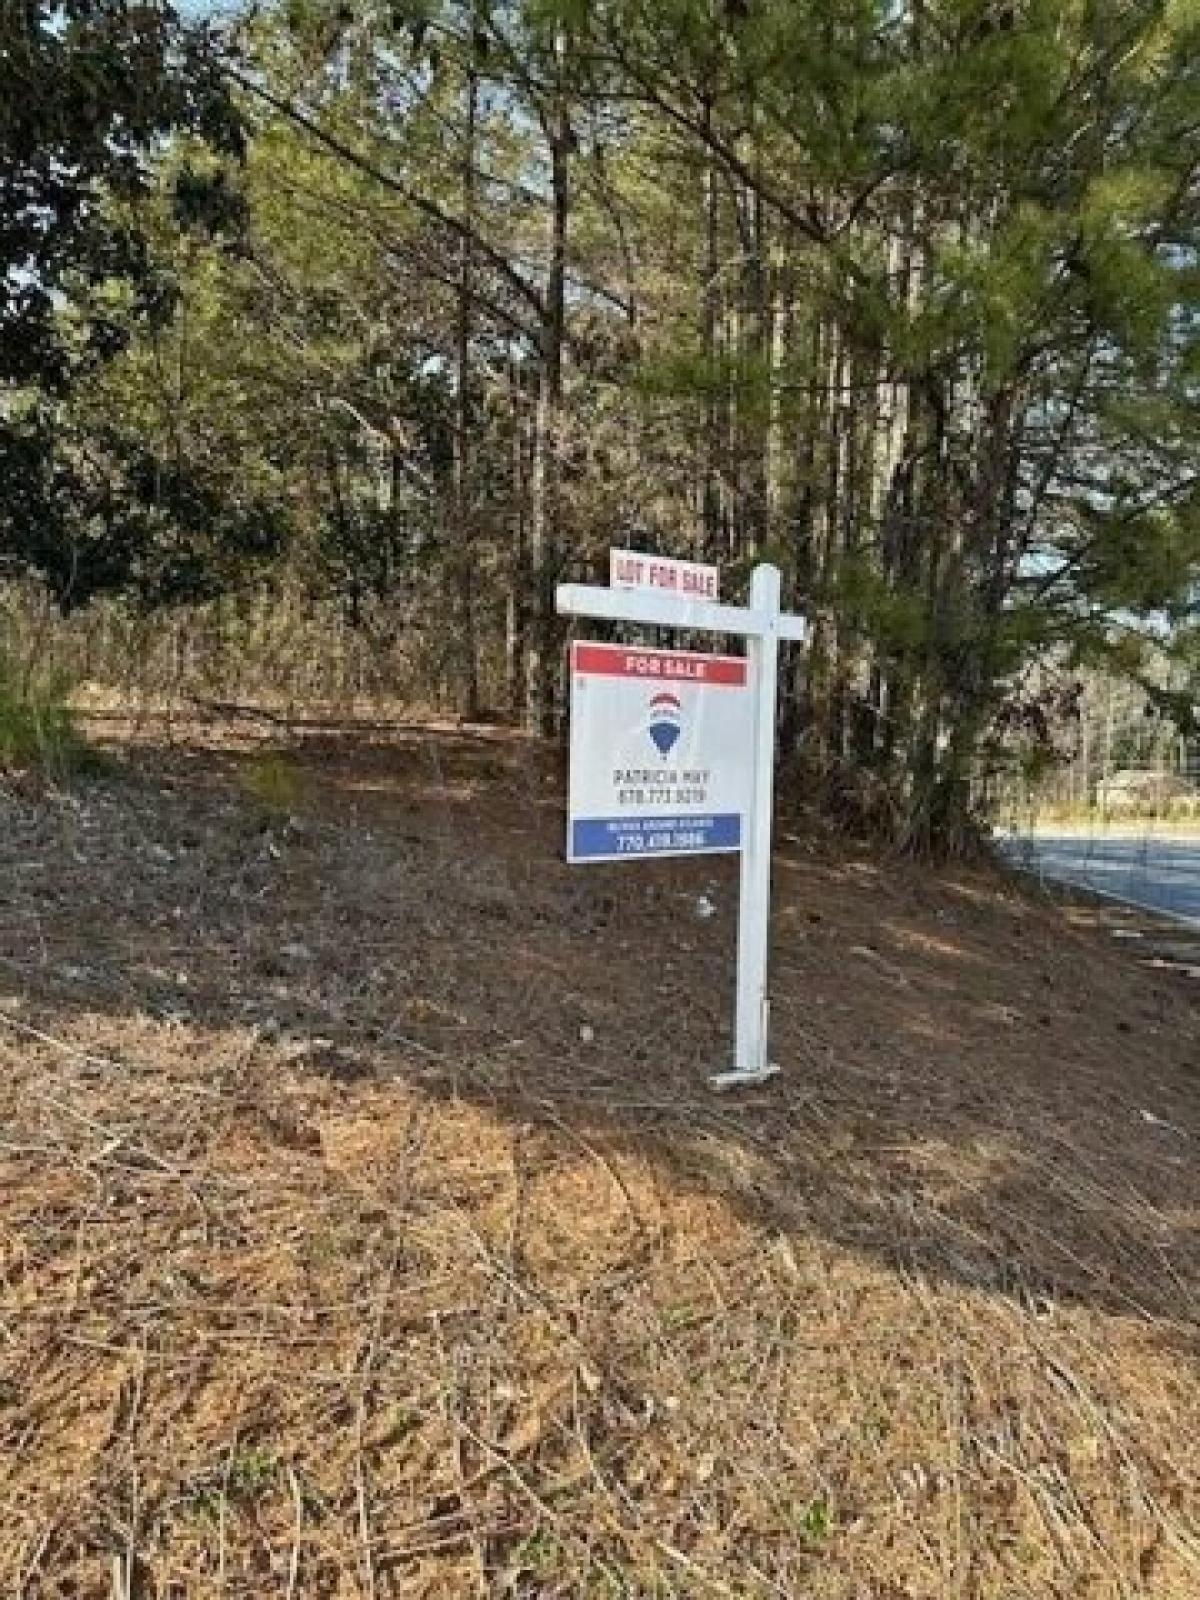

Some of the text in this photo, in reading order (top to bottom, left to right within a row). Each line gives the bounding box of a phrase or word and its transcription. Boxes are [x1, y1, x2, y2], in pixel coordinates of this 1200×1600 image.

[650, 563, 678, 588] FOR
[682, 569, 714, 597] SALE
[625, 655, 705, 678] FOR SALE
